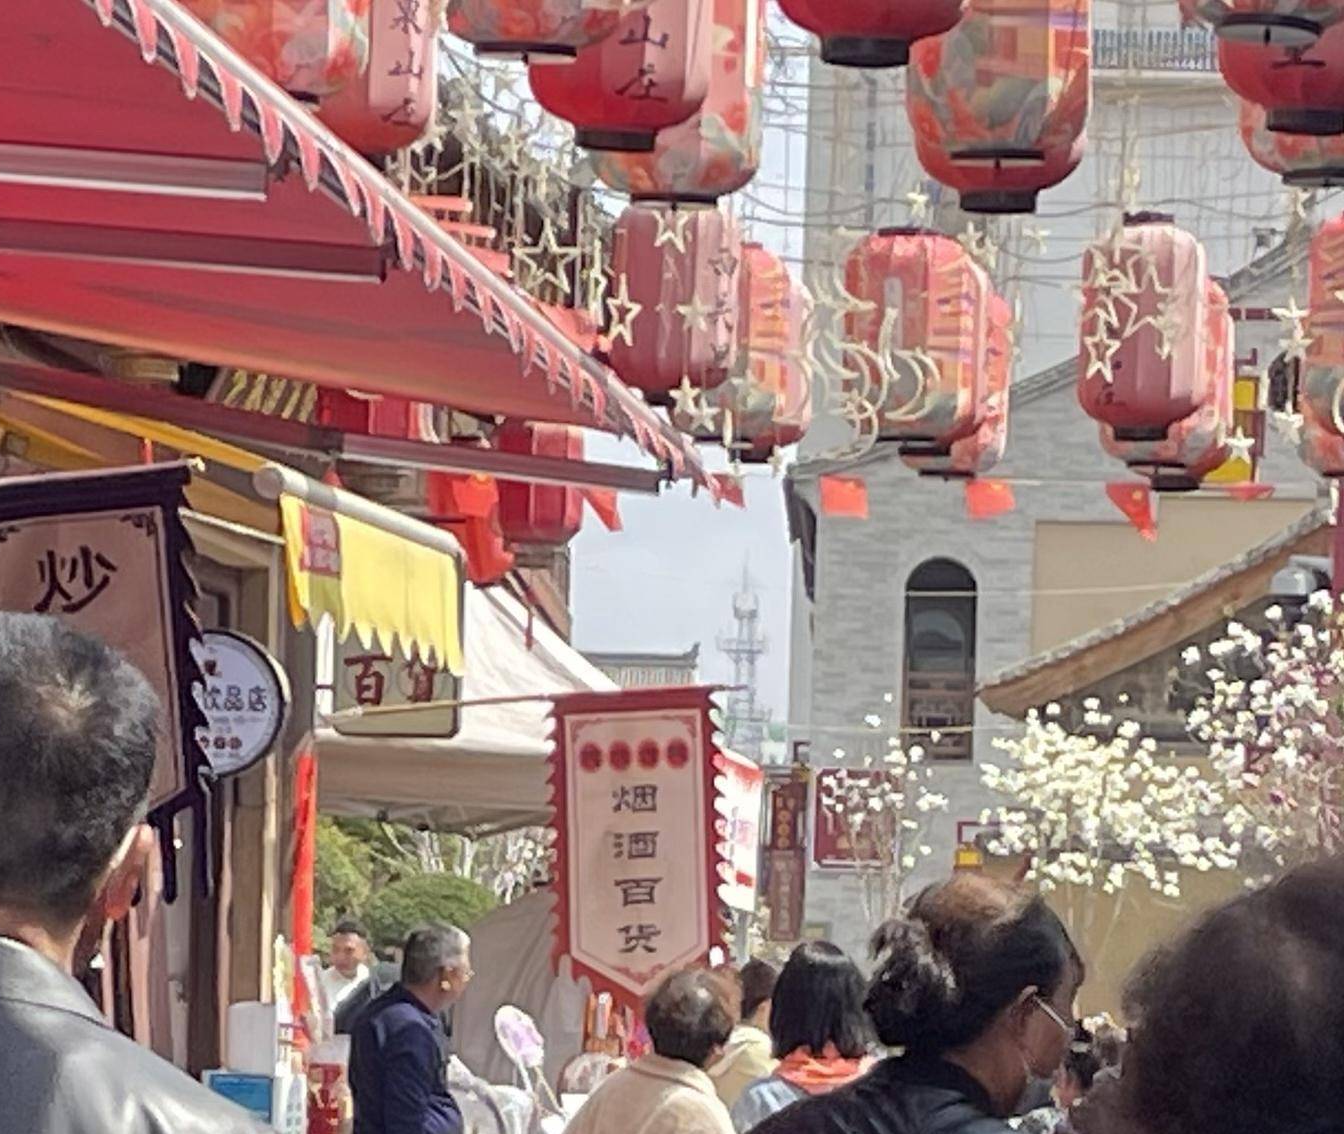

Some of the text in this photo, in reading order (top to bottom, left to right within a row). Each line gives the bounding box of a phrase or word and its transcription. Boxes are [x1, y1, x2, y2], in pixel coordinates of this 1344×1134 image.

[33, 545, 117, 613] 炒
[612, 783, 663, 953] 烟酒百货
